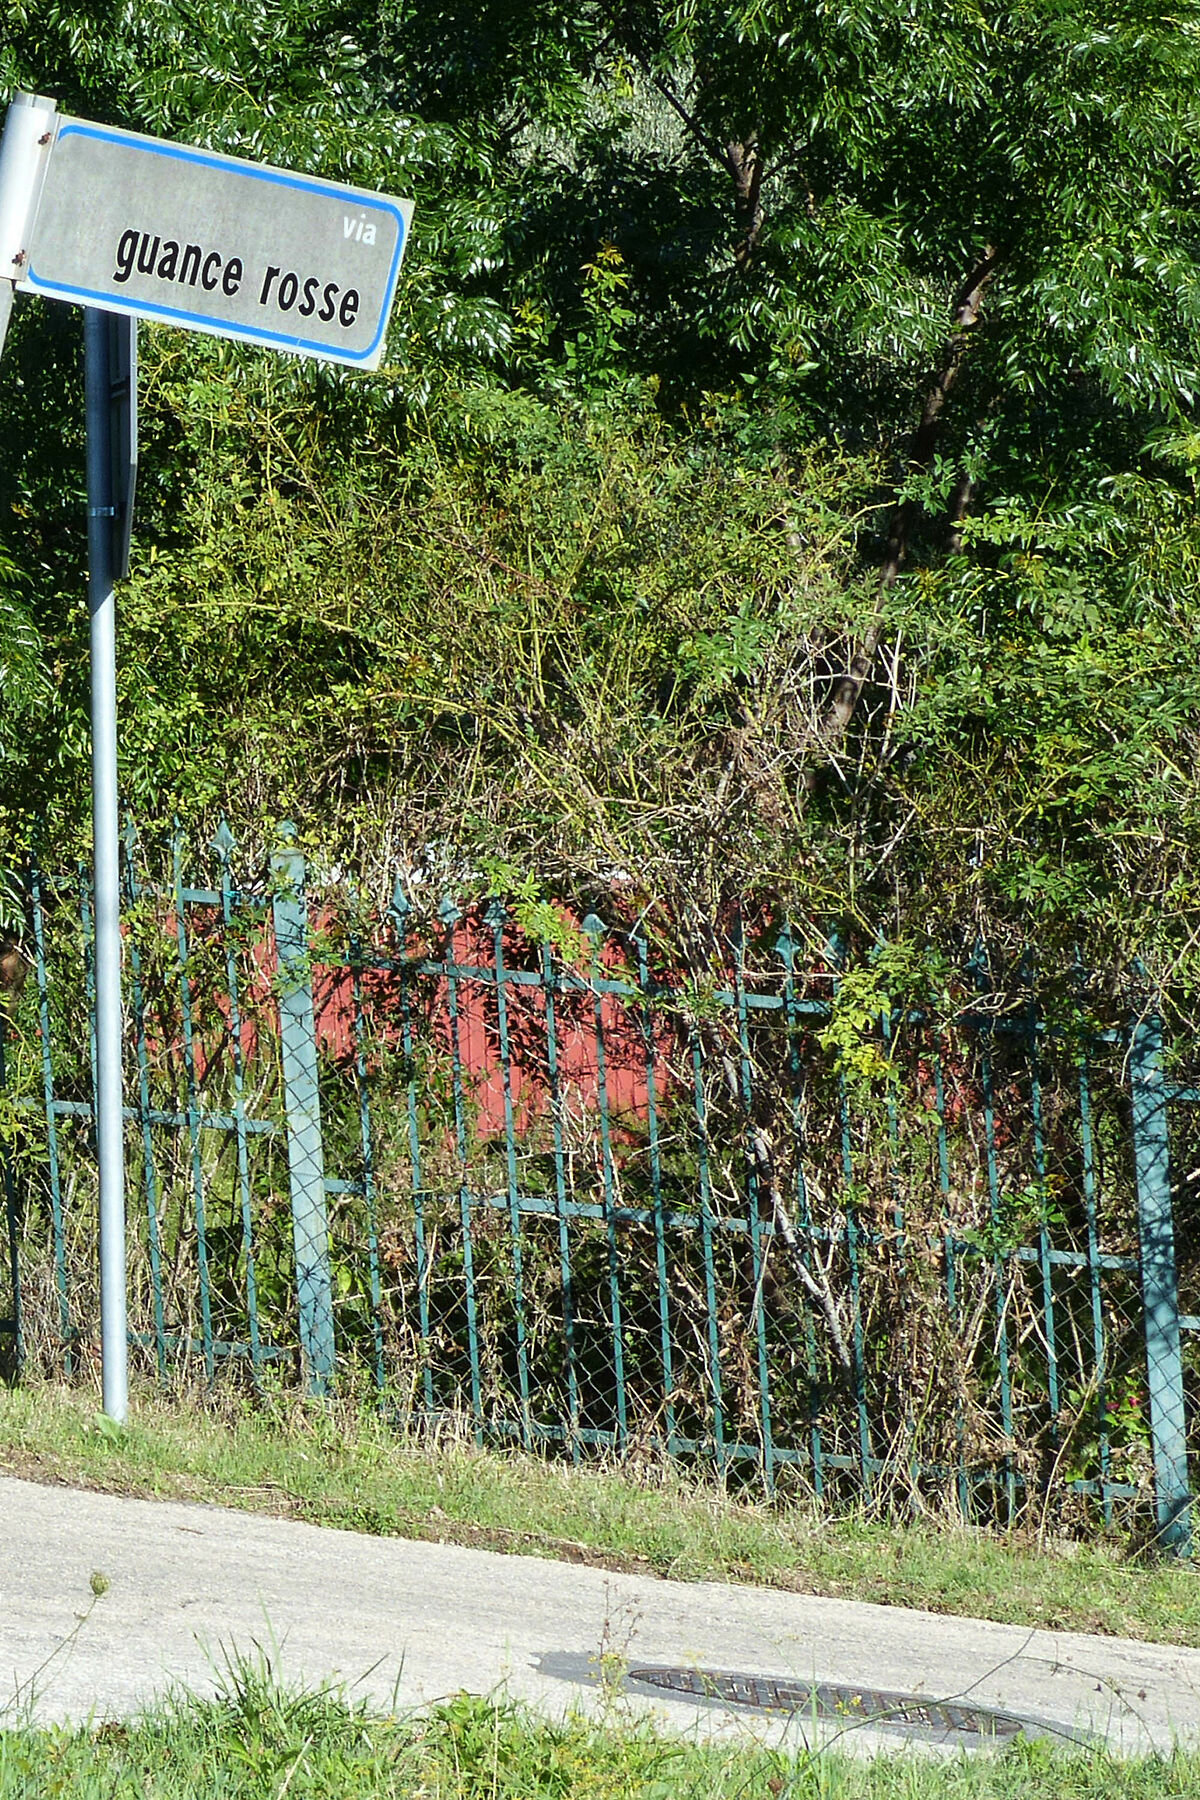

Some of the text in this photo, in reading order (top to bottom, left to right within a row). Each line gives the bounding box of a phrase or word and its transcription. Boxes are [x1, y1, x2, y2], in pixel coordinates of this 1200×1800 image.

[343, 214, 376, 245] via
[113, 229, 360, 327] guance rosse
